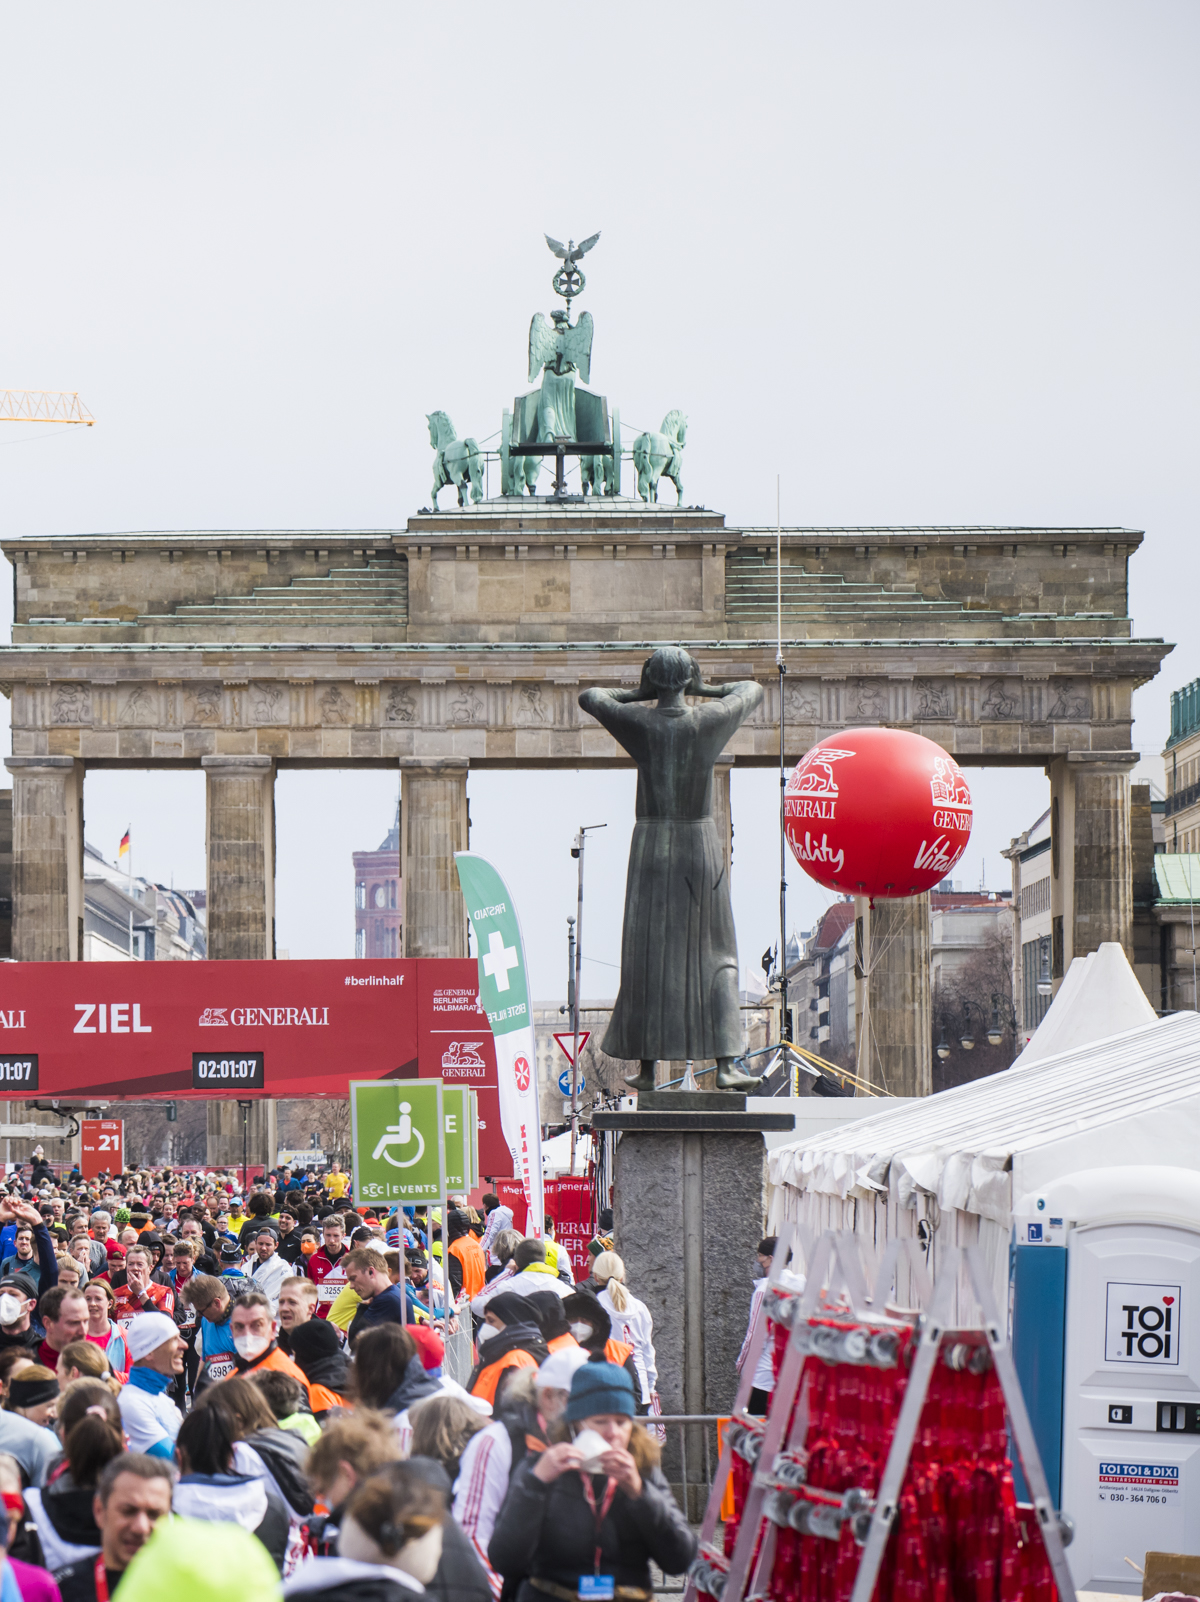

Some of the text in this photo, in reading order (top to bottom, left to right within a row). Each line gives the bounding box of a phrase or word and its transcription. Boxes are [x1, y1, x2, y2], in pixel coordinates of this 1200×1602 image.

[344, 974, 405, 986] #berlinhalf
[73, 1003, 152, 1034] ZIEL
[230, 1007, 329, 1026] GENERALI
[198, 1060, 257, 1079] 02:01:07
[442, 1069, 486, 1077] GENERALI
[98, 1134, 119, 1151] 21
[362, 1182, 438, 1198] SCC EVENTS
[1122, 1304, 1172, 1332] TOI
[1121, 1331, 1171, 1358] TOI
[1101, 1464, 1177, 1478] TOI TOI & DIXI
[1110, 1493, 1125, 1502] 030
[1130, 1494, 1144, 1503] 364
[1146, 1495, 1160, 1504] 706
[1161, 1496, 1167, 1504] 0
